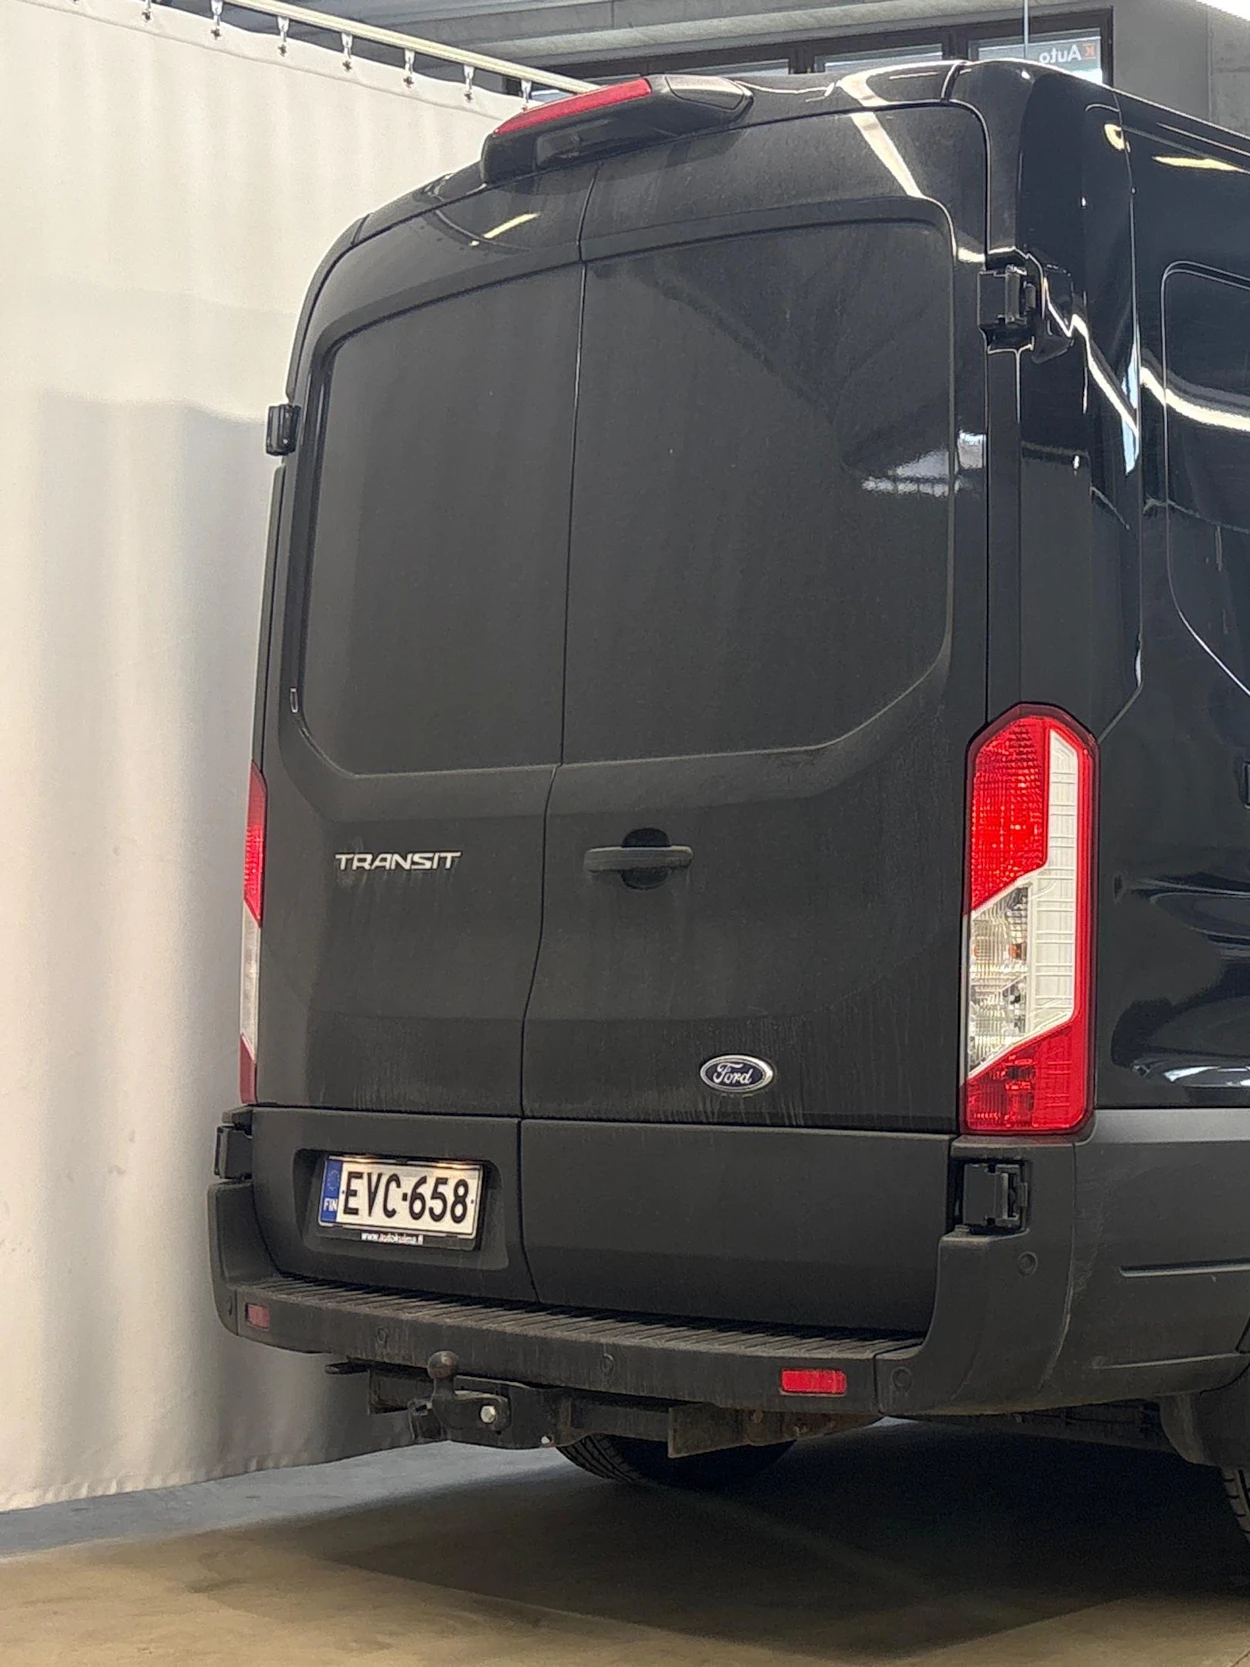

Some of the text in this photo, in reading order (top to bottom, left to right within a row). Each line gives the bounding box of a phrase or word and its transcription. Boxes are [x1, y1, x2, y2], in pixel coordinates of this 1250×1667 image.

[335, 851, 461, 871] TRANSIT
[712, 1062, 754, 1084] Ford
[323, 1198, 338, 1212] FIN
[343, 1171, 470, 1225] EVC-658
